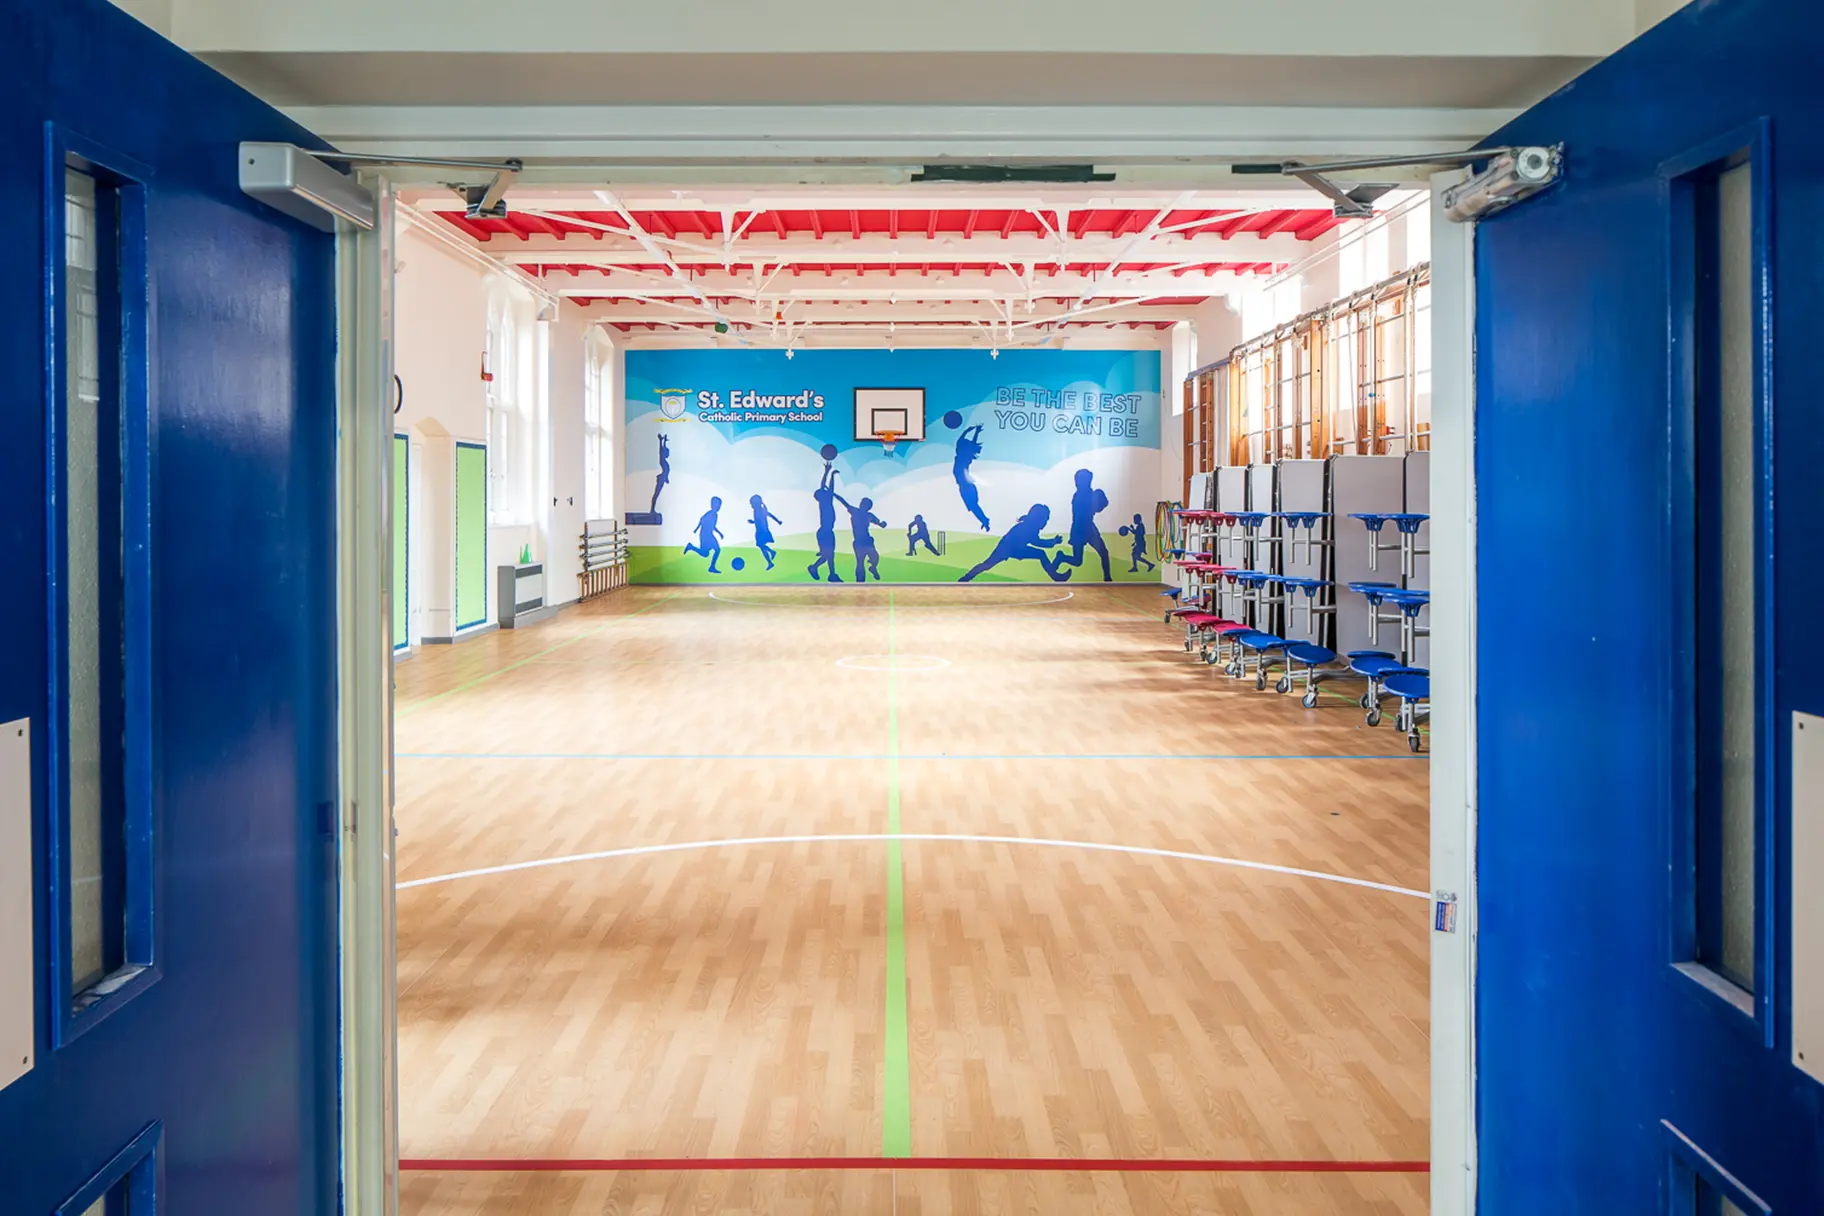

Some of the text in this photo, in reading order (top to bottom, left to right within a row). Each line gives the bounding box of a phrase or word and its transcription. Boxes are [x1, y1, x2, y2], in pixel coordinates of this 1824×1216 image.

[697, 389, 825, 410] St. Edward's
[996, 386, 1142, 415] BE THE BEST
[699, 411, 823, 425] Catholic Primary School
[994, 409, 1139, 438] YOU CAN BE
